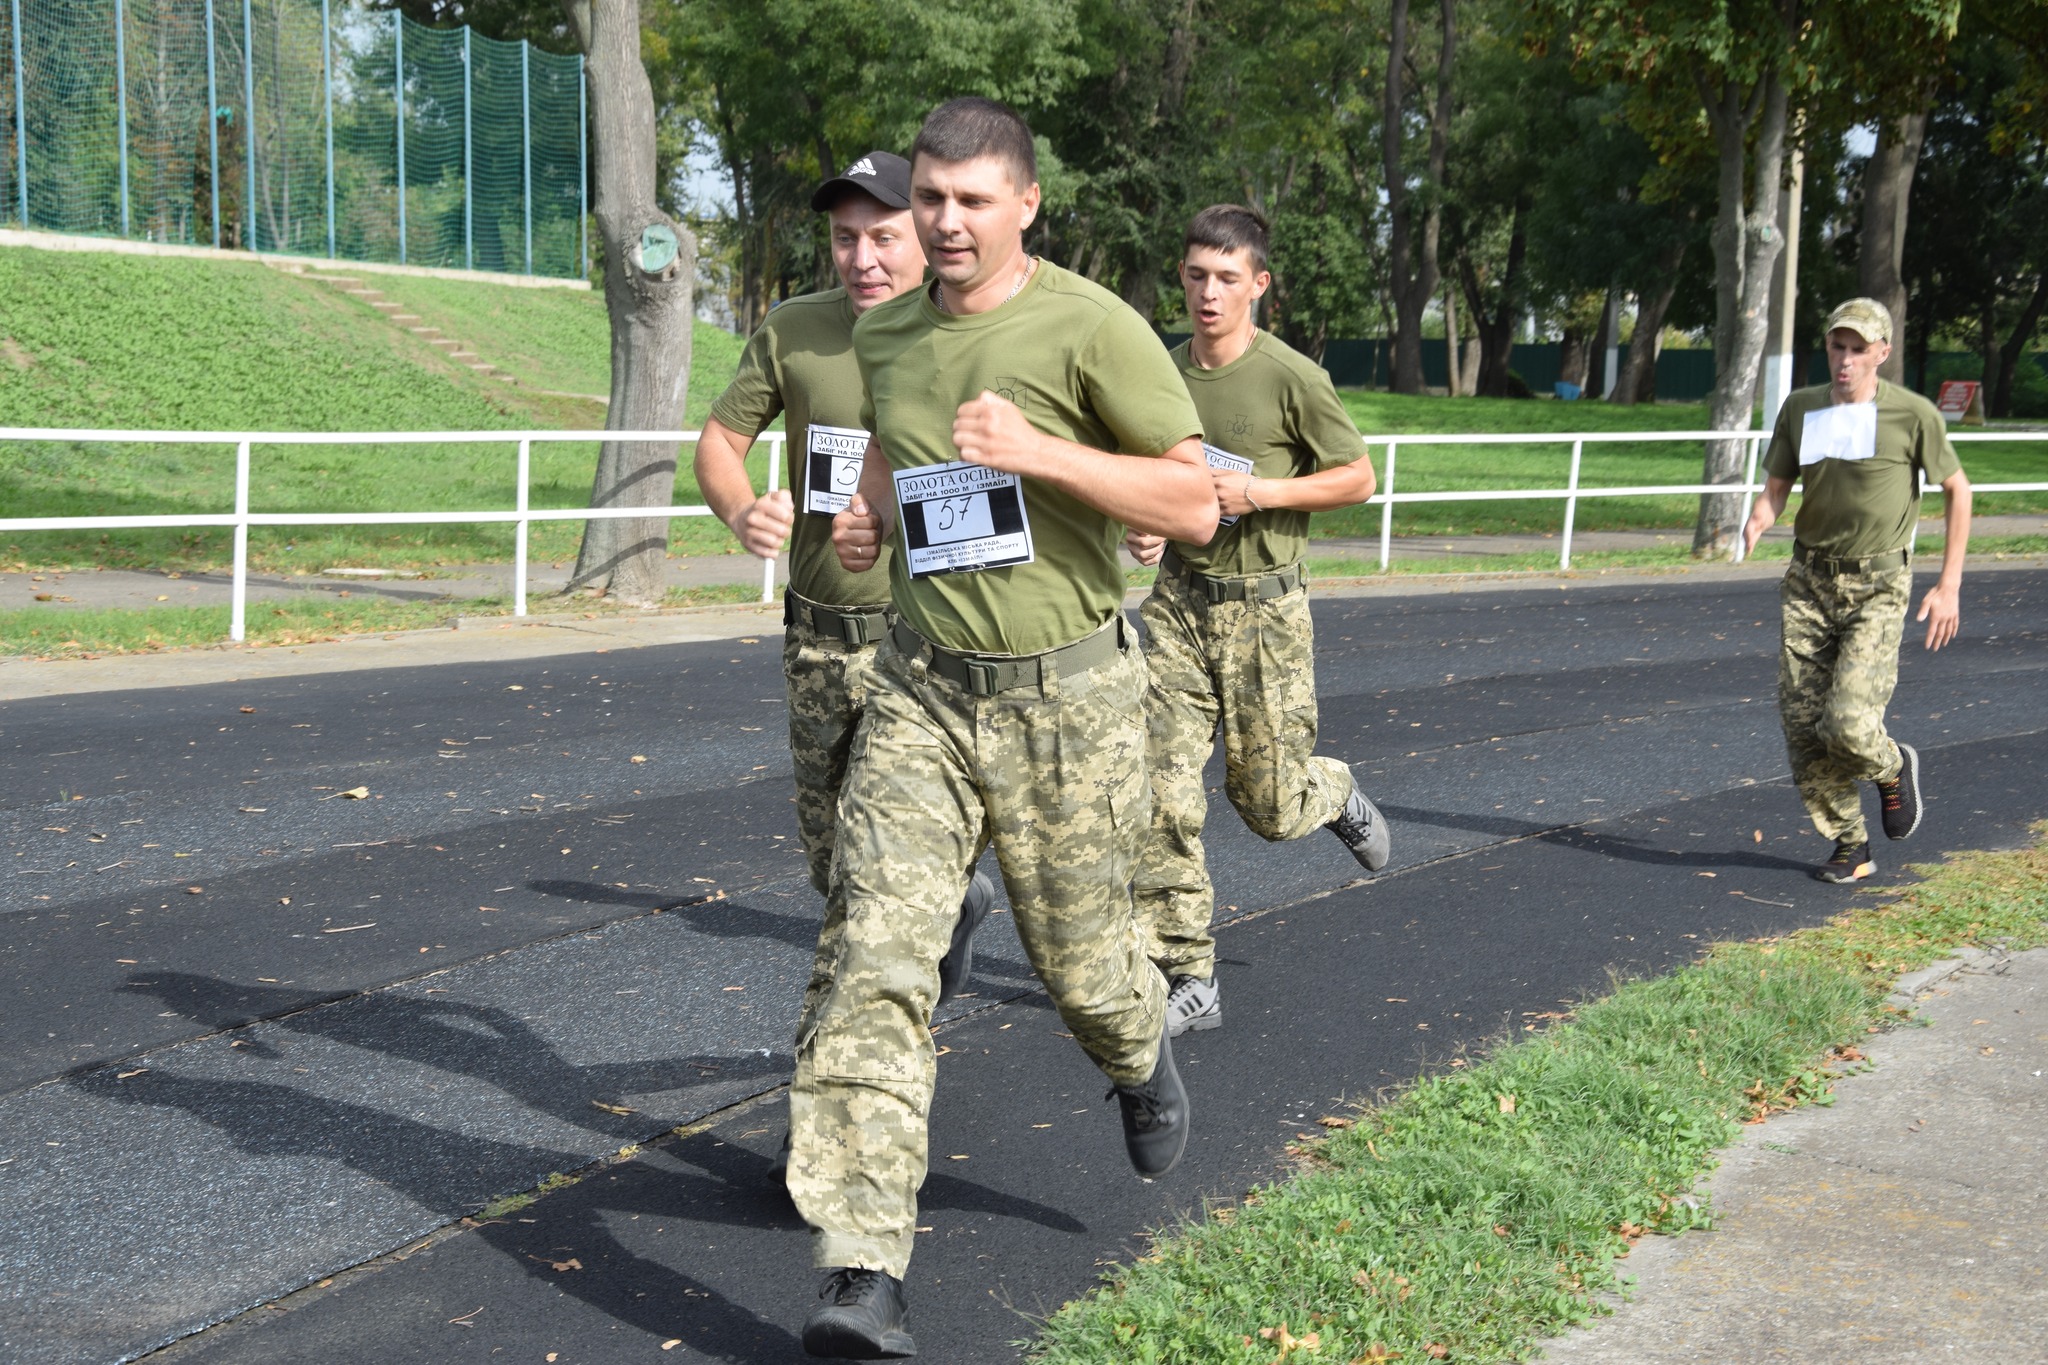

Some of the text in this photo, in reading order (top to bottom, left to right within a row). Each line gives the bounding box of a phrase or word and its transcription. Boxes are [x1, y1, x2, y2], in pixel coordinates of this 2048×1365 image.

[817, 435, 866, 450] ЗОЛОТА
[903, 473, 956, 494] ЗОЛОТА
[905, 491, 924, 501] ЗАБІГ
[926, 490, 938, 498] НА
[940, 487, 960, 495] 1000
[976, 478, 1007, 490] ІЗМАЇЛ
[938, 495, 973, 531] 57
[996, 543, 1019, 551] СПОРТУ
